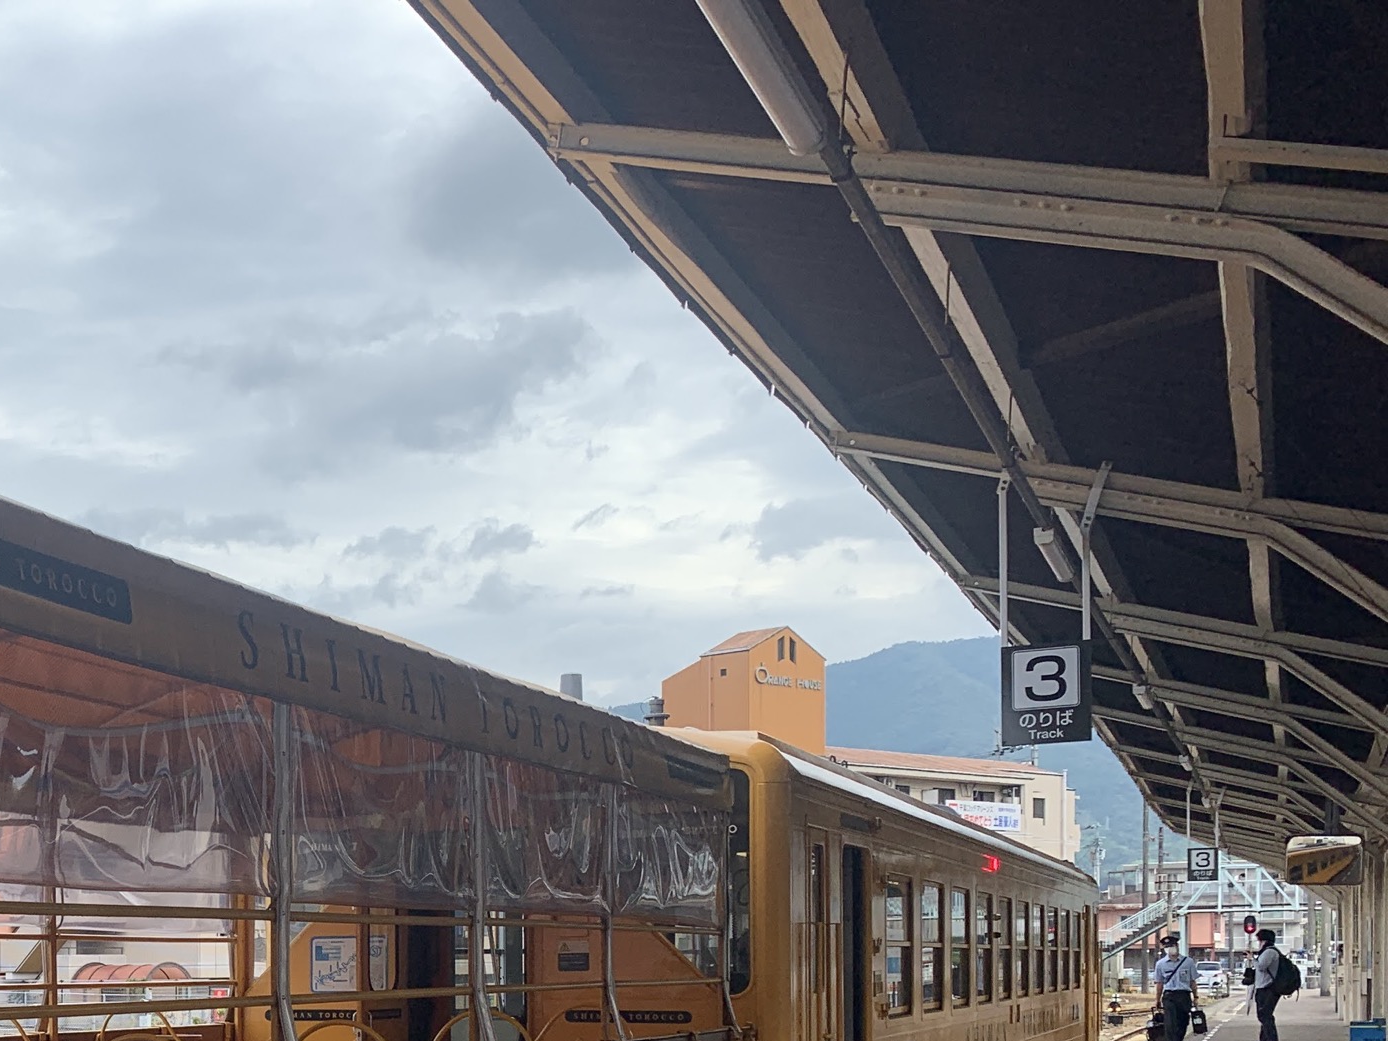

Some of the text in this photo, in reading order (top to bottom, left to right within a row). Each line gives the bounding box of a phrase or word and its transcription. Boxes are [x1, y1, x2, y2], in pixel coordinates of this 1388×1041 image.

[16, 558, 118, 608] TOROCCO
[796, 678, 822, 691] HOUSE
[1024, 654, 1068, 702] 3
[236, 609, 635, 771] SHIMAN TOROCCO
[1019, 708, 1074, 728] のりば
[1028, 728, 1065, 740] Track
[1195, 851, 1211, 868] 3
[318, 1011, 352, 1019] TOROC
